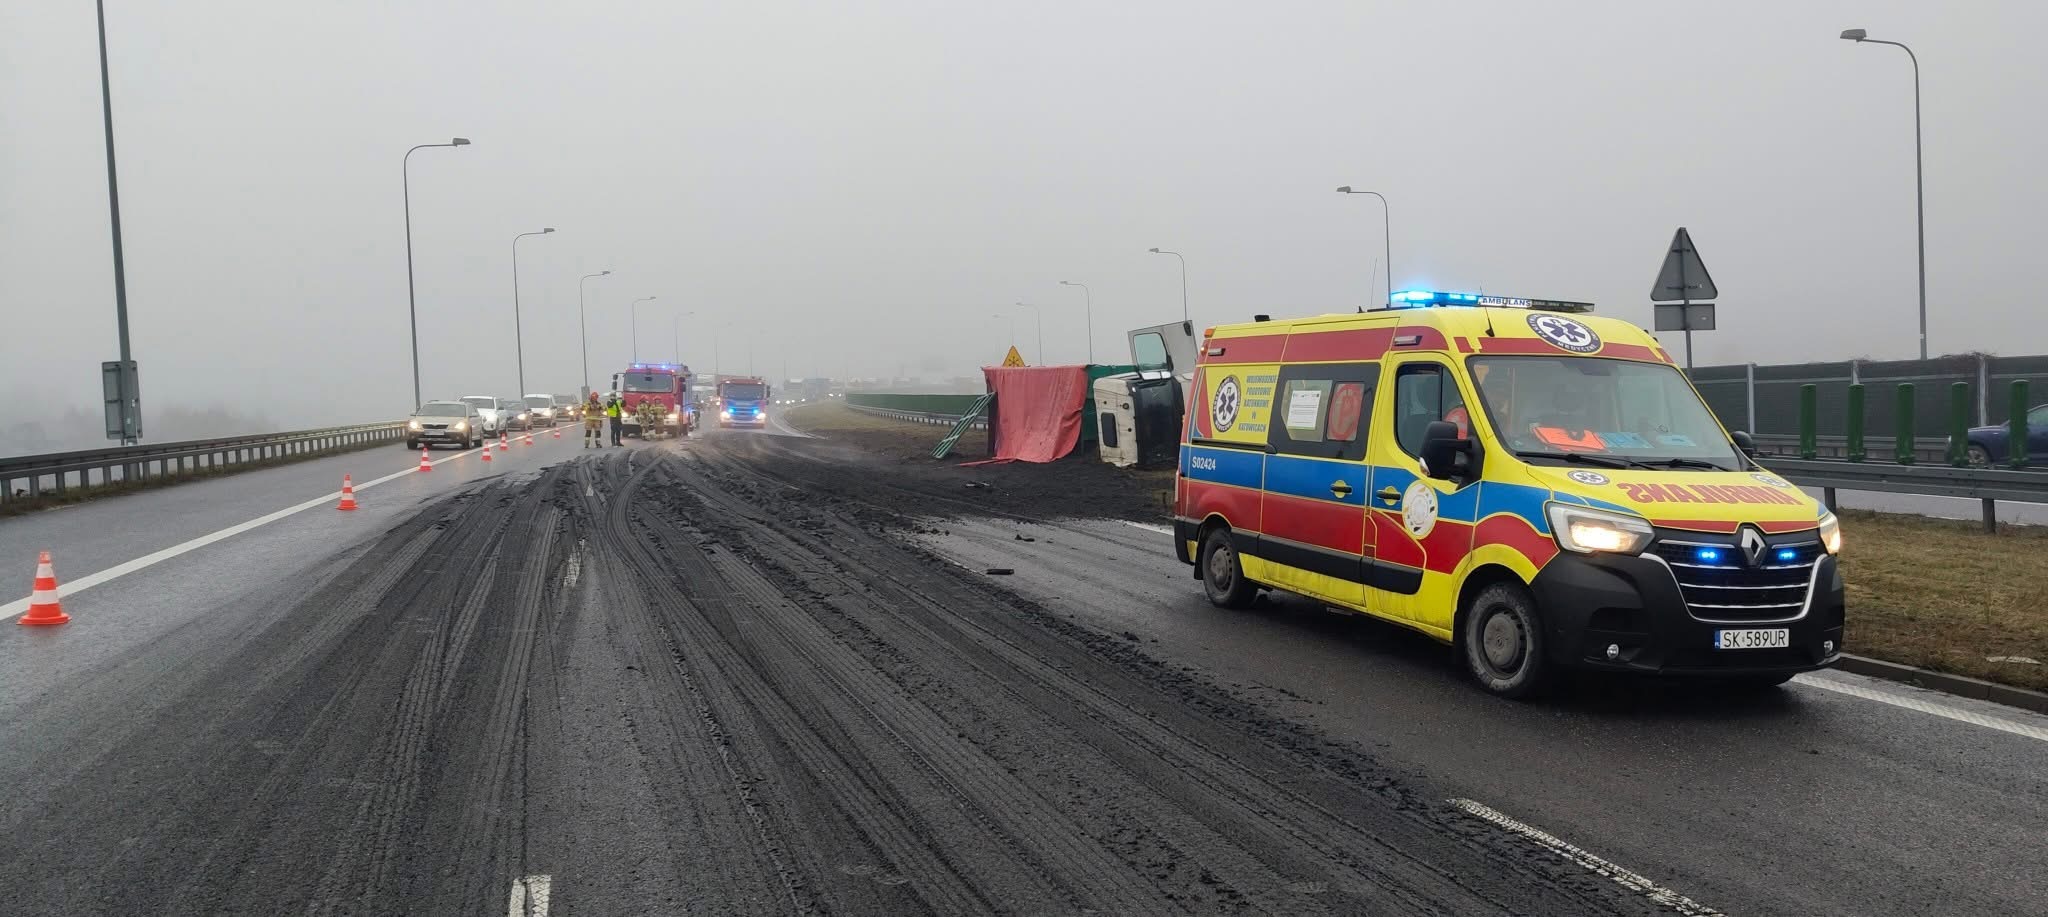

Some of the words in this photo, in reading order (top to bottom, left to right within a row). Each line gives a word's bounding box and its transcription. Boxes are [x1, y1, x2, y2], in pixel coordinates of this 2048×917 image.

[1482, 298, 1531, 307] AMBULANS
[1192, 456, 1216, 470] S02424
[1723, 631, 1740, 648] SK
[1746, 630, 1786, 647] 589UR
